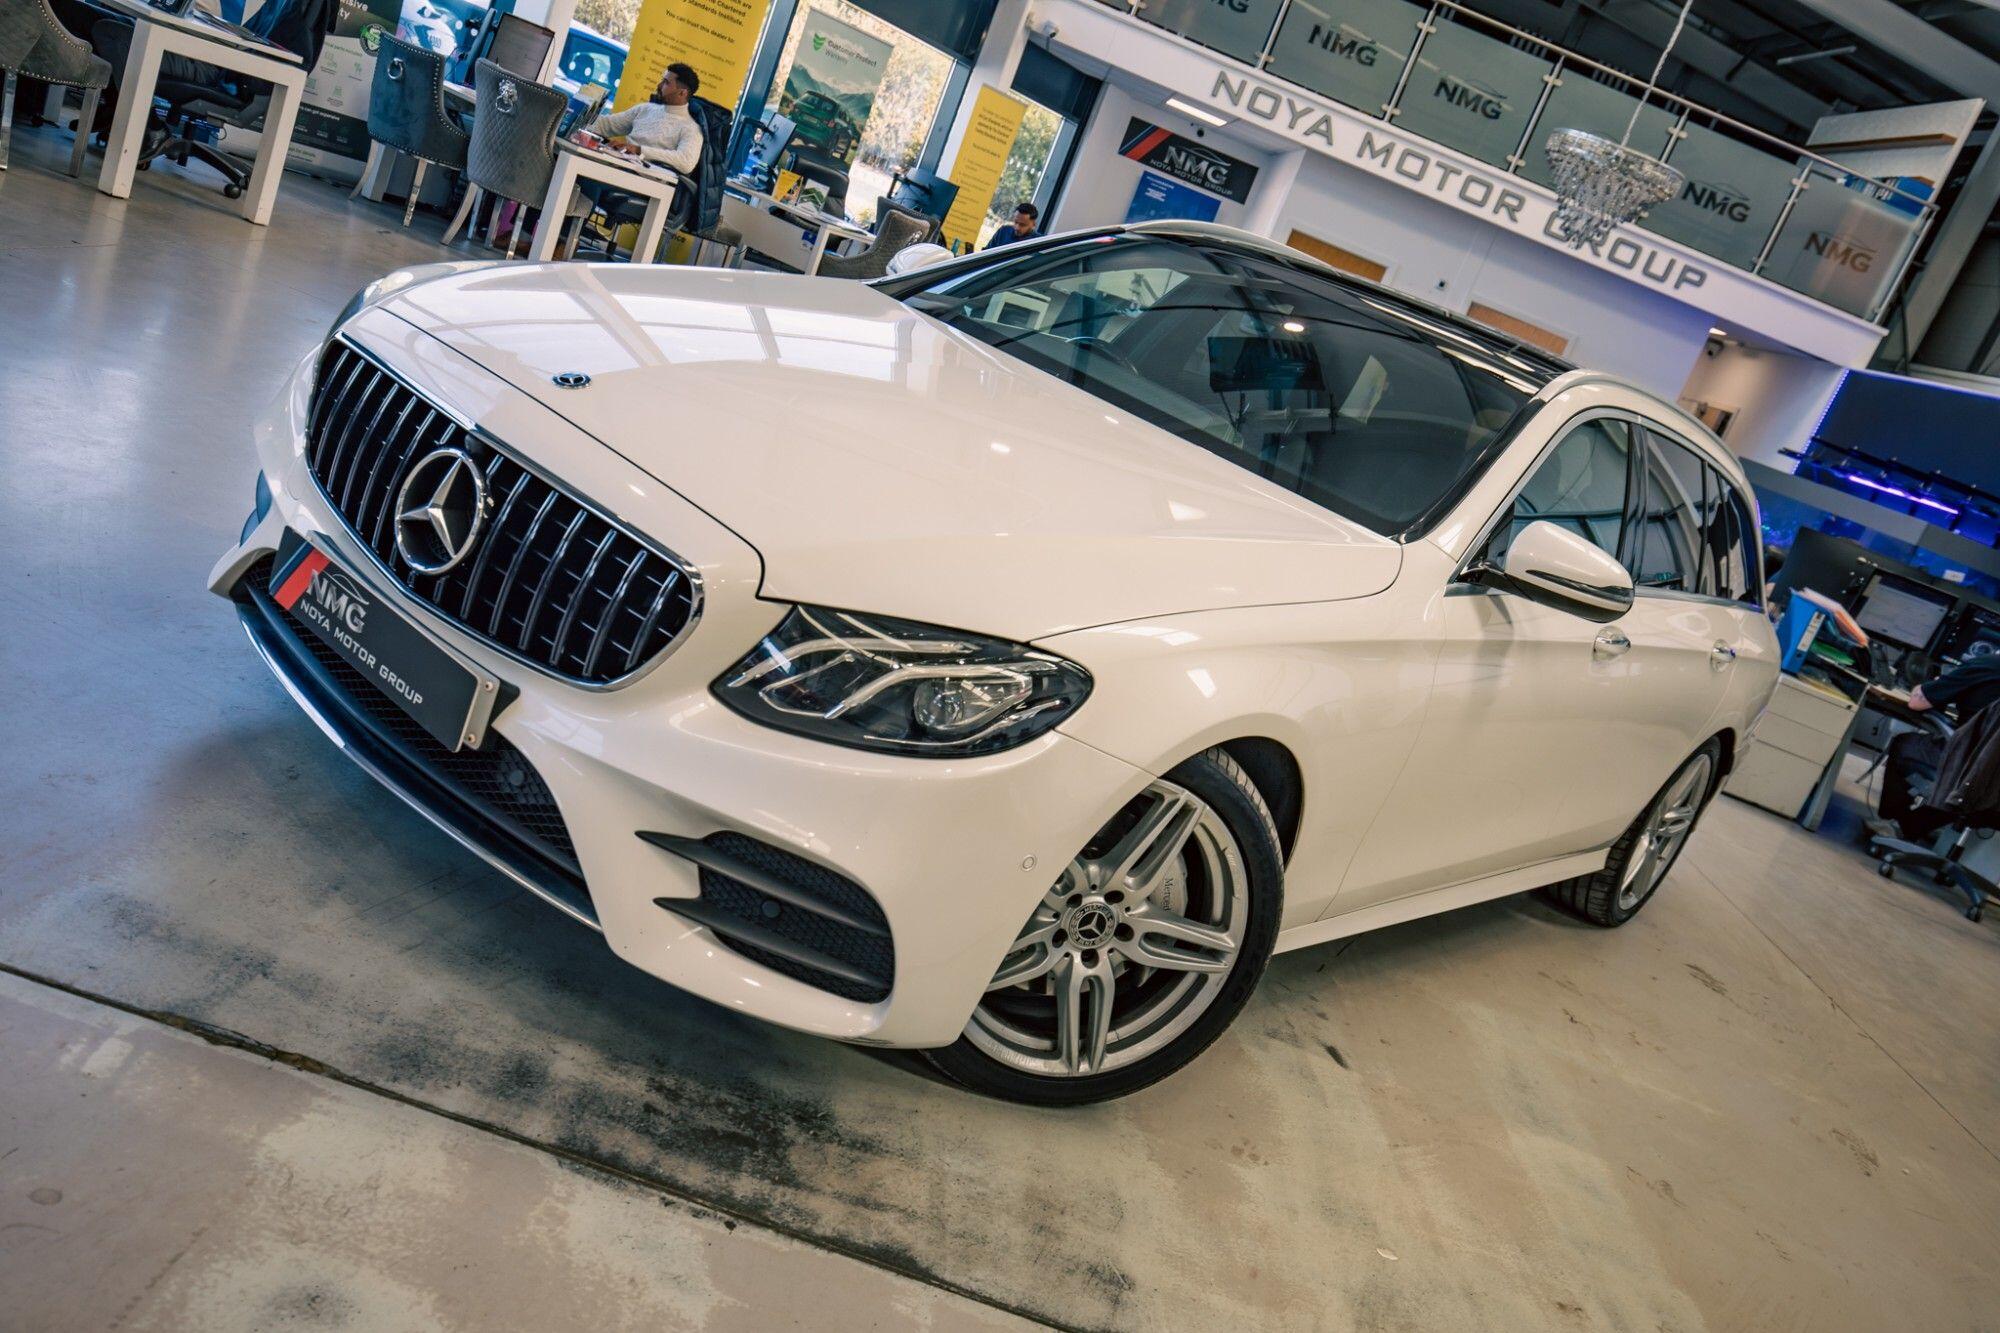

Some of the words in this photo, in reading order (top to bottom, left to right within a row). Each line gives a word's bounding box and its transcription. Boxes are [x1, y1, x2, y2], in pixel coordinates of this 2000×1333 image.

[1308, 24, 1378, 67] NMG
[1433, 77, 1503, 121] NMG
[1164, 145, 1228, 186] NMG
[1211, 70, 1334, 146] NOYA
[1357, 131, 1526, 223] MOTOR
[1150, 160, 1172, 172] NOYA
[1173, 169, 1203, 184] MOTOR
[1204, 182, 1233, 196] GROUP
[1681, 181, 1751, 223] NMG
[1803, 232, 1873, 273] NMG
[305, 568, 368, 634] NMG
[300, 600, 331, 632] NOYA
[333, 627, 377, 670] MOTOR
[379, 664, 424, 704] GROUP
